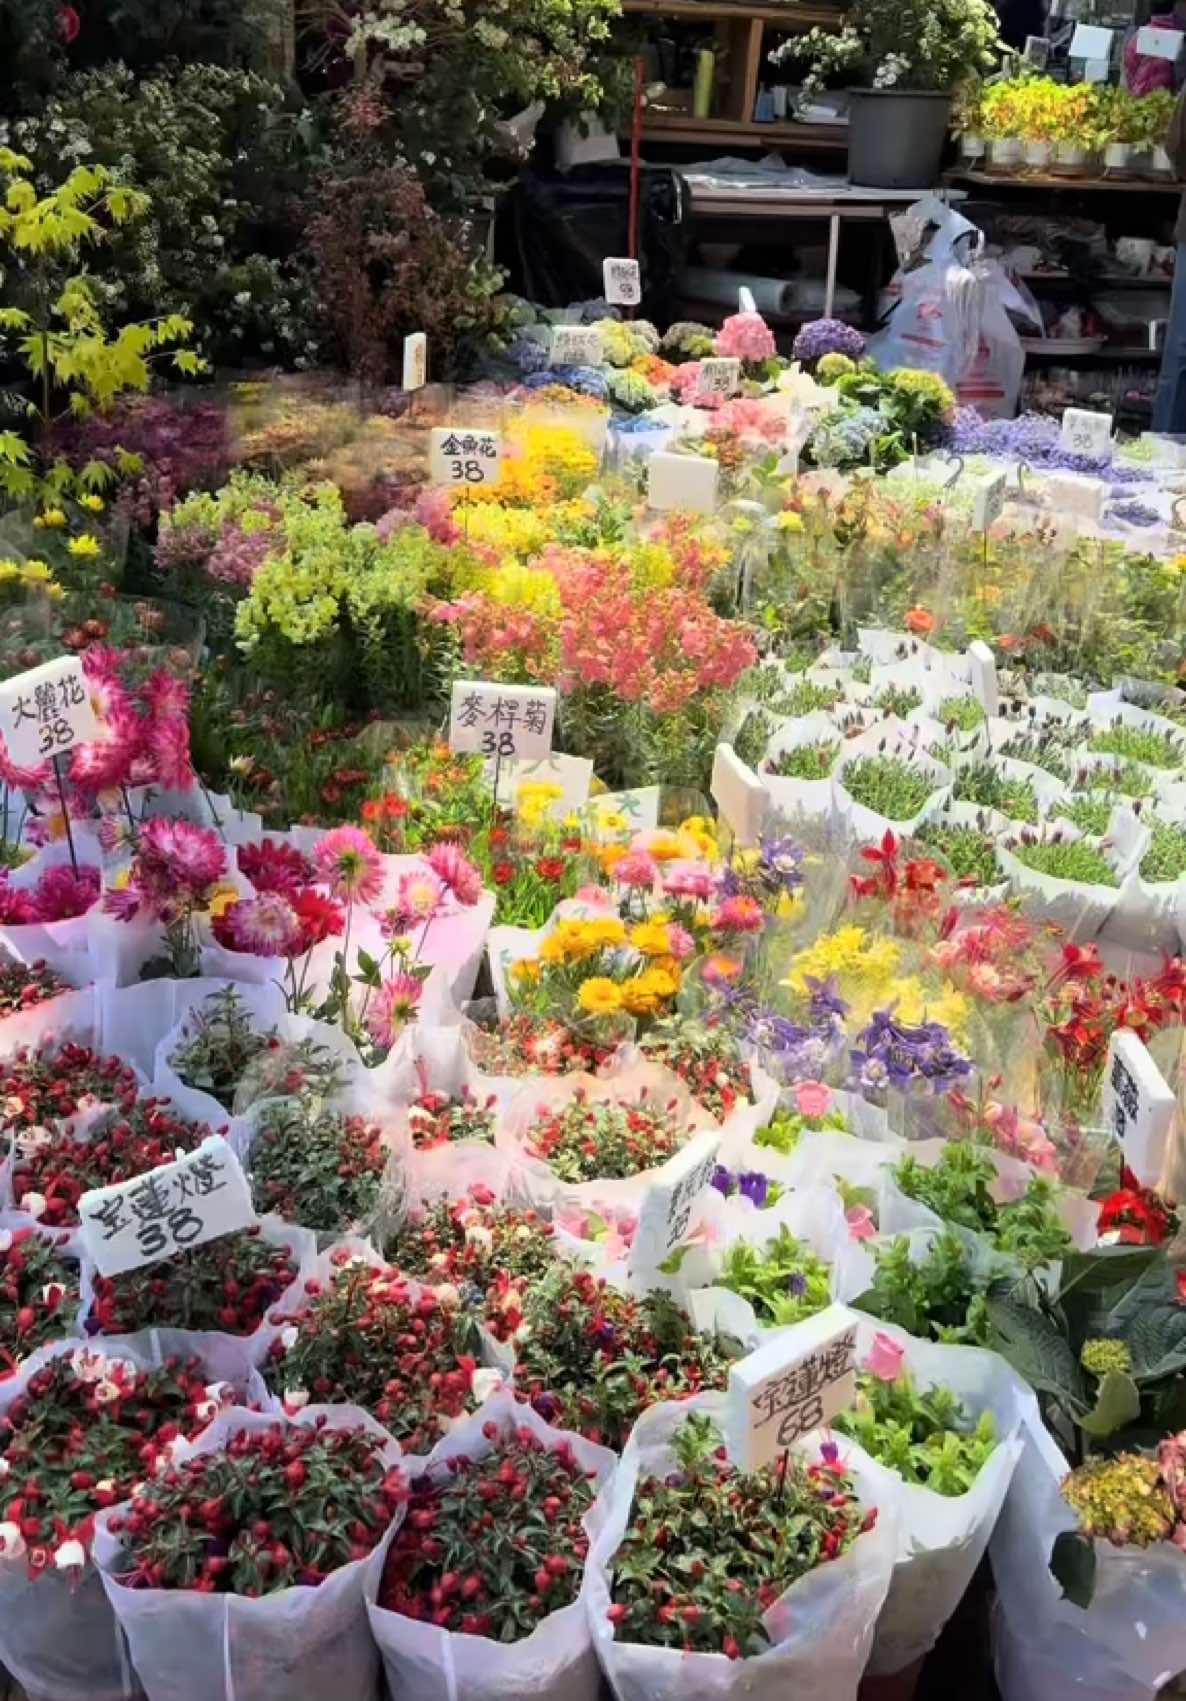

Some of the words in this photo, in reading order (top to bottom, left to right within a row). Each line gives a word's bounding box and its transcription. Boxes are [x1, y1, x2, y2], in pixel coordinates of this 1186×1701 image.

[451, 460, 485, 482] 38
[38, 718, 74, 753] 38
[481, 730, 516, 756] 38
[136, 1207, 204, 1256] 38
[777, 1395, 823, 1445] 68
